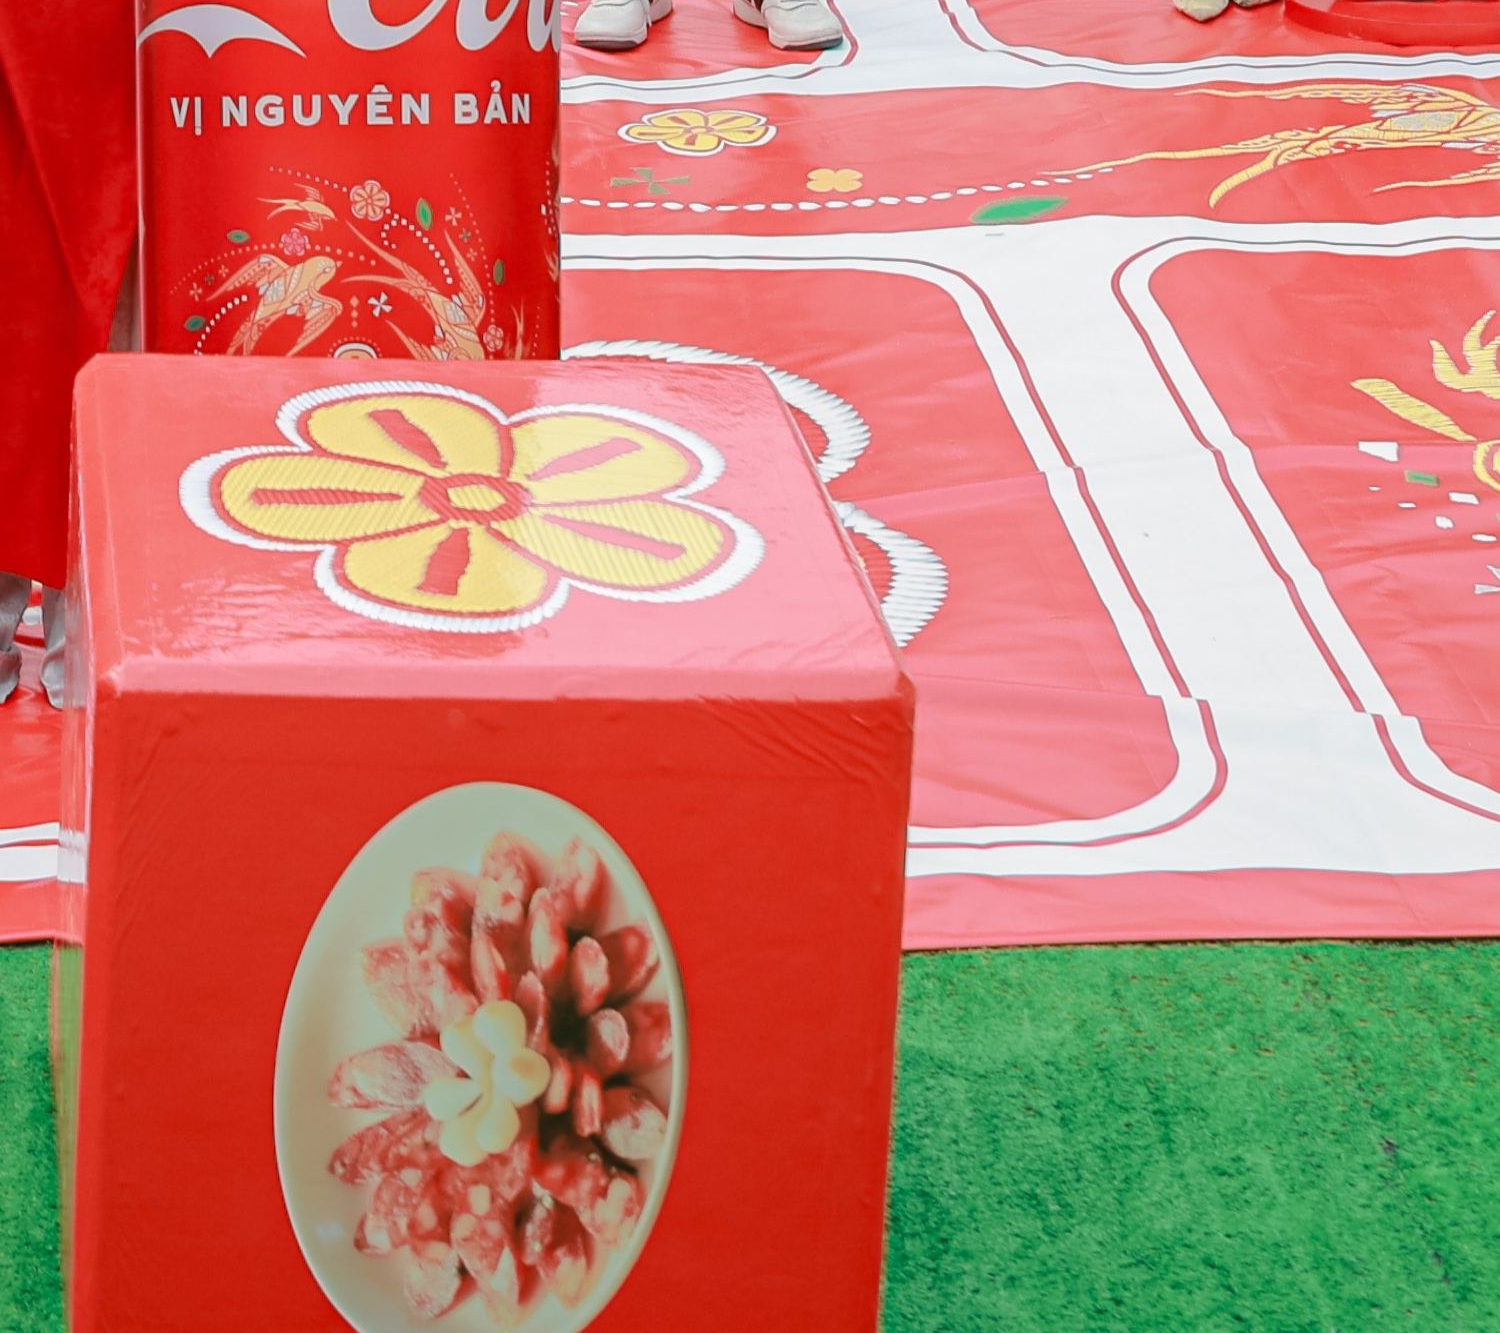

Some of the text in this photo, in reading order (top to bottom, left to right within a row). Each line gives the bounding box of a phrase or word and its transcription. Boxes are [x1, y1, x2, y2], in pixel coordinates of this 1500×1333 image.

[170, 79, 531, 136] VỊ NGUYÊN BẢN
